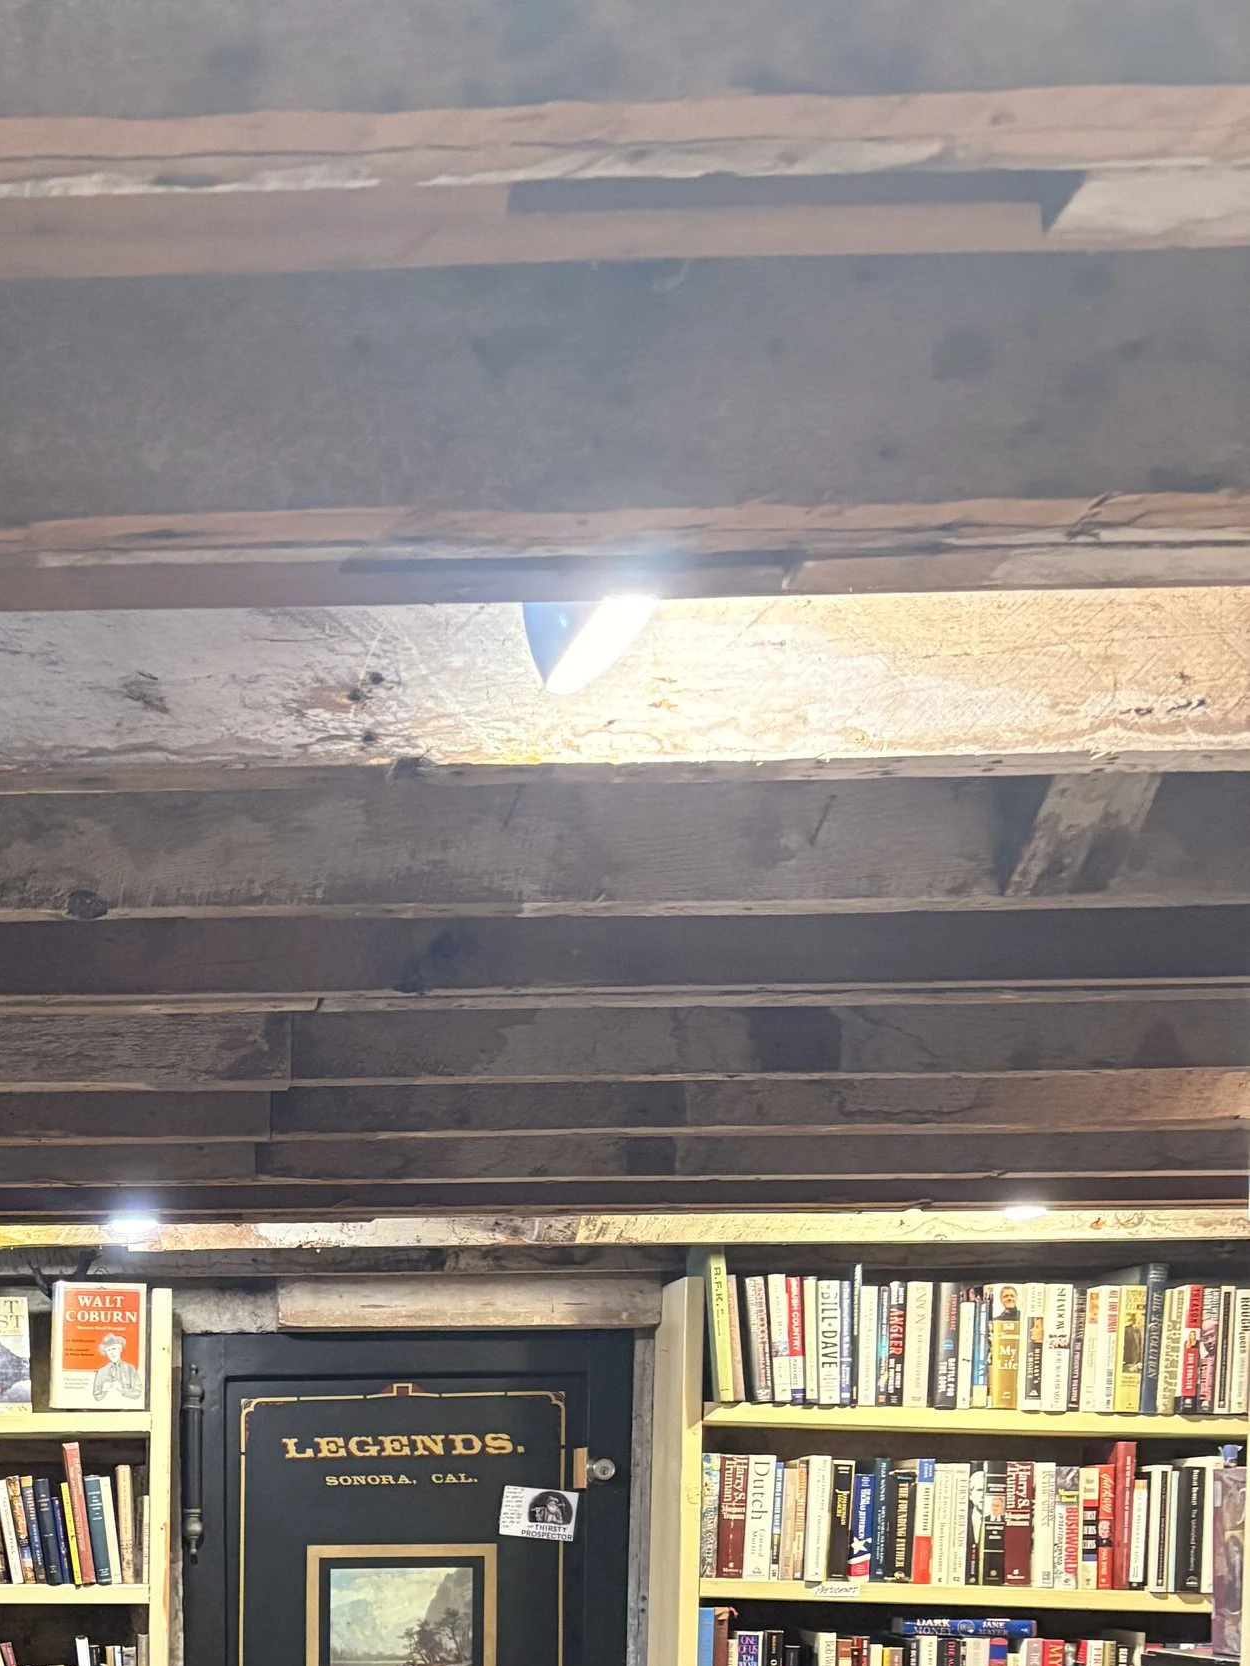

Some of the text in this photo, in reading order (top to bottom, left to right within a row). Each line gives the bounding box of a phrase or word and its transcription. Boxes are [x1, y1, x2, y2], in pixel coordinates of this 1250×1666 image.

[713, 1267, 724, 1307] R.F.K.
[77, 1295, 124, 1308] WALT
[1056, 1288, 1069, 1330] SHADOW
[1190, 1288, 1201, 1323] TREASON
[65, 1310, 138, 1324] COBURN
[888, 1308, 904, 1356] ANGLER
[999, 1345, 1016, 1356] My
[948, 1358, 956, 1381] BATTLE
[997, 1359, 1018, 1370] Life
[1186, 1353, 1195, 1389] ANN COULTER
[281, 1433, 525, 1459] LEGENDS.
[326, 1473, 478, 1486] SONORA, CAL.
[723, 1458, 736, 1502] Truman
[734, 1458, 747, 1502] Harry S.
[751, 1461, 770, 1520] Dutch
[1006, 1464, 1019, 1509] Truman
[1017, 1465, 1031, 1509] Harry S.
[521, 1530, 573, 1541] PROSPECTOR
[535, 1524, 568, 1533] THIRSTY
[895, 1483, 908, 1567] THE FOUNDING FATHER
[1064, 1507, 1078, 1574] BUSHWORLD
[914, 1626, 952, 1635] MONEY
[916, 1618, 950, 1627] DARK
[978, 1628, 1010, 1636] MAYER
[740, 1636, 757, 1646] ONE
[1030, 1652, 1039, 1665] THE
[1049, 1645, 1063, 1666] MY
